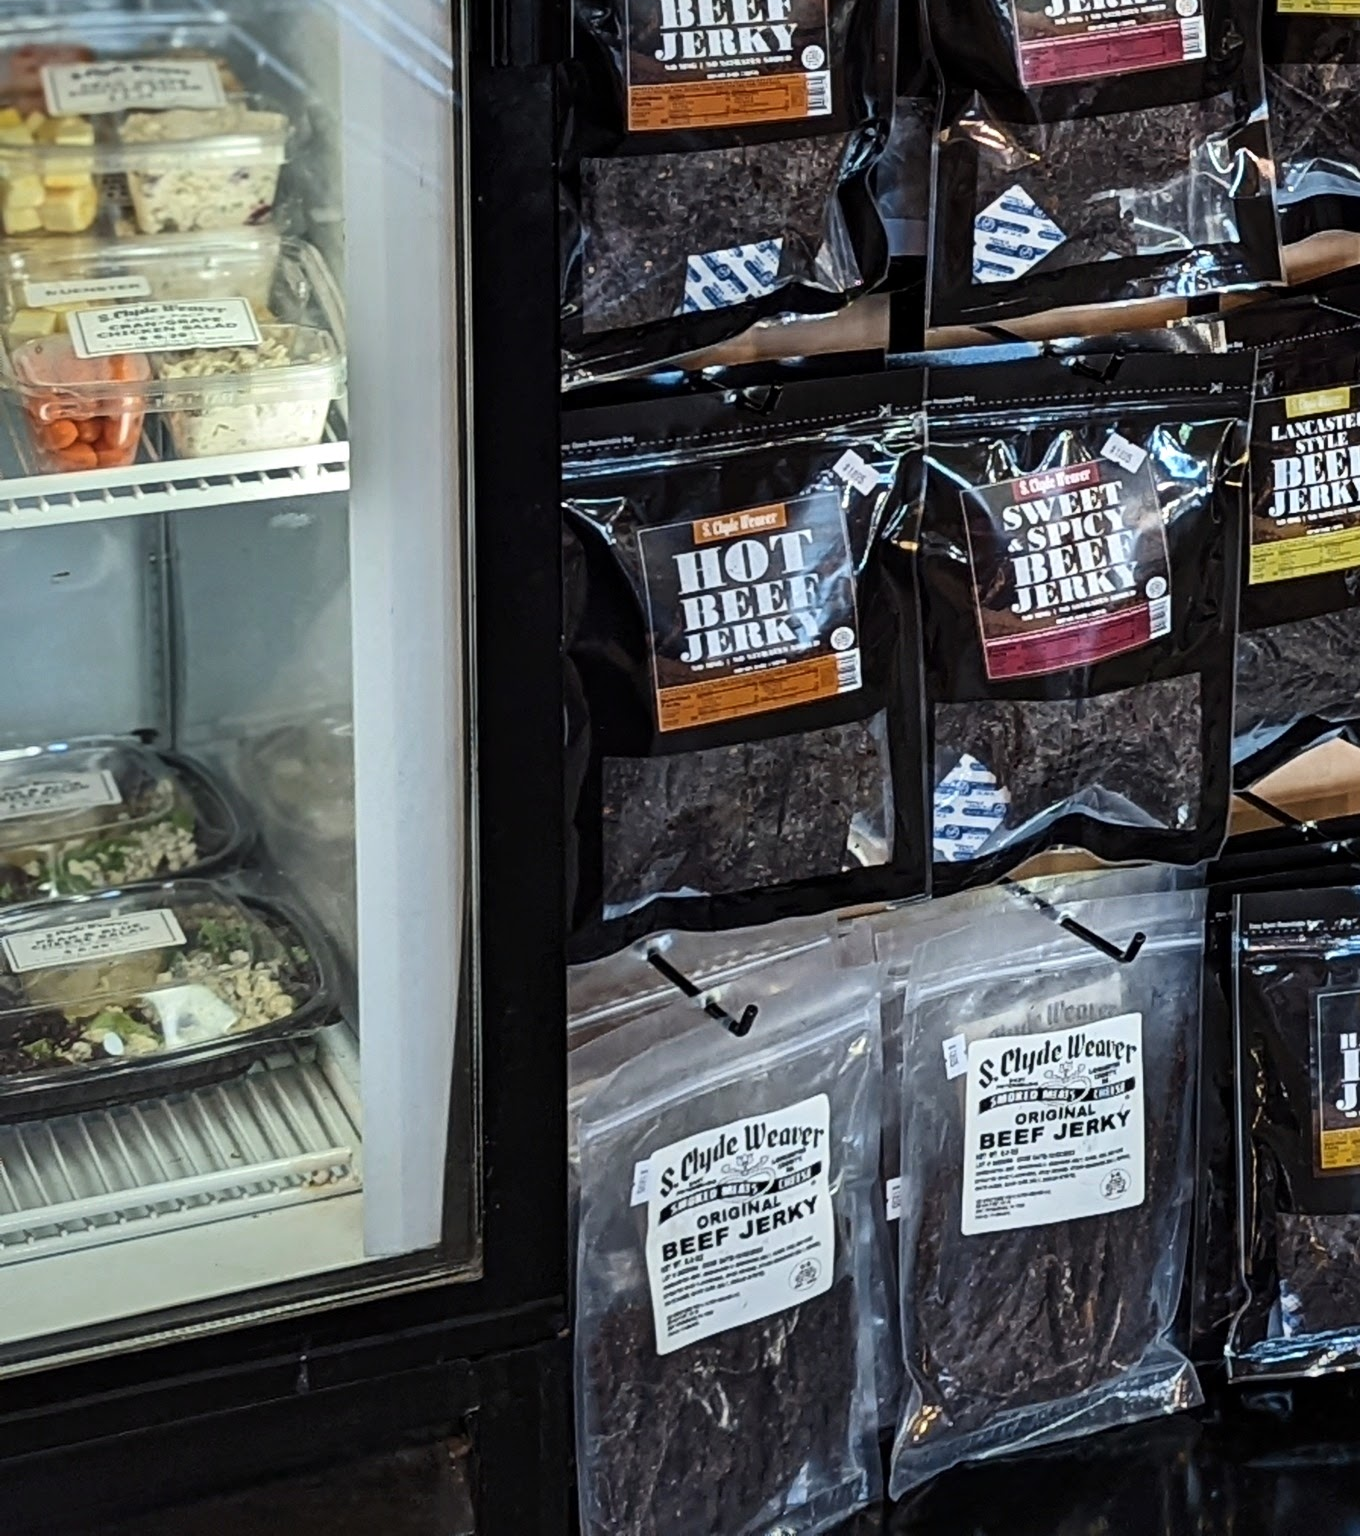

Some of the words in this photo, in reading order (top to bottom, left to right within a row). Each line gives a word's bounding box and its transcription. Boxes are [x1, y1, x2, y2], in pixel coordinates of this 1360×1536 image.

[654, 22, 799, 62] JERKY
[1295, 431, 1349, 455] STYLE
[1002, 481, 1123, 532] SWEET
[1007, 538, 1023, 553] &
[1027, 506, 1128, 554] SPICY
[672, 529, 814, 596] HOT
[1011, 529, 1135, 587] BEEF
[680, 572, 820, 633] BEEF
[1011, 561, 1138, 615] JERKY
[680, 608, 824, 663] JERKY
[978, 1059, 999, 1089] S.
[1000, 1040, 1061, 1078] Clyde
[1067, 1032, 1138, 1064] Weaver
[990, 1089, 1038, 1109] SMOKED
[1042, 1088, 1076, 1101] MEATS
[1015, 1103, 1097, 1126] ORIGINAL
[979, 1127, 1045, 1150] BEEF
[1053, 1109, 1131, 1141] JERKY
[659, 1166, 680, 1199] S.
[681, 1133, 739, 1182] Clyde
[743, 1121, 825, 1153] Weaver
[662, 1226, 730, 1263] BEEF
[739, 1195, 819, 1240] JERKY
[696, 1194, 782, 1231] ORIGINAL
